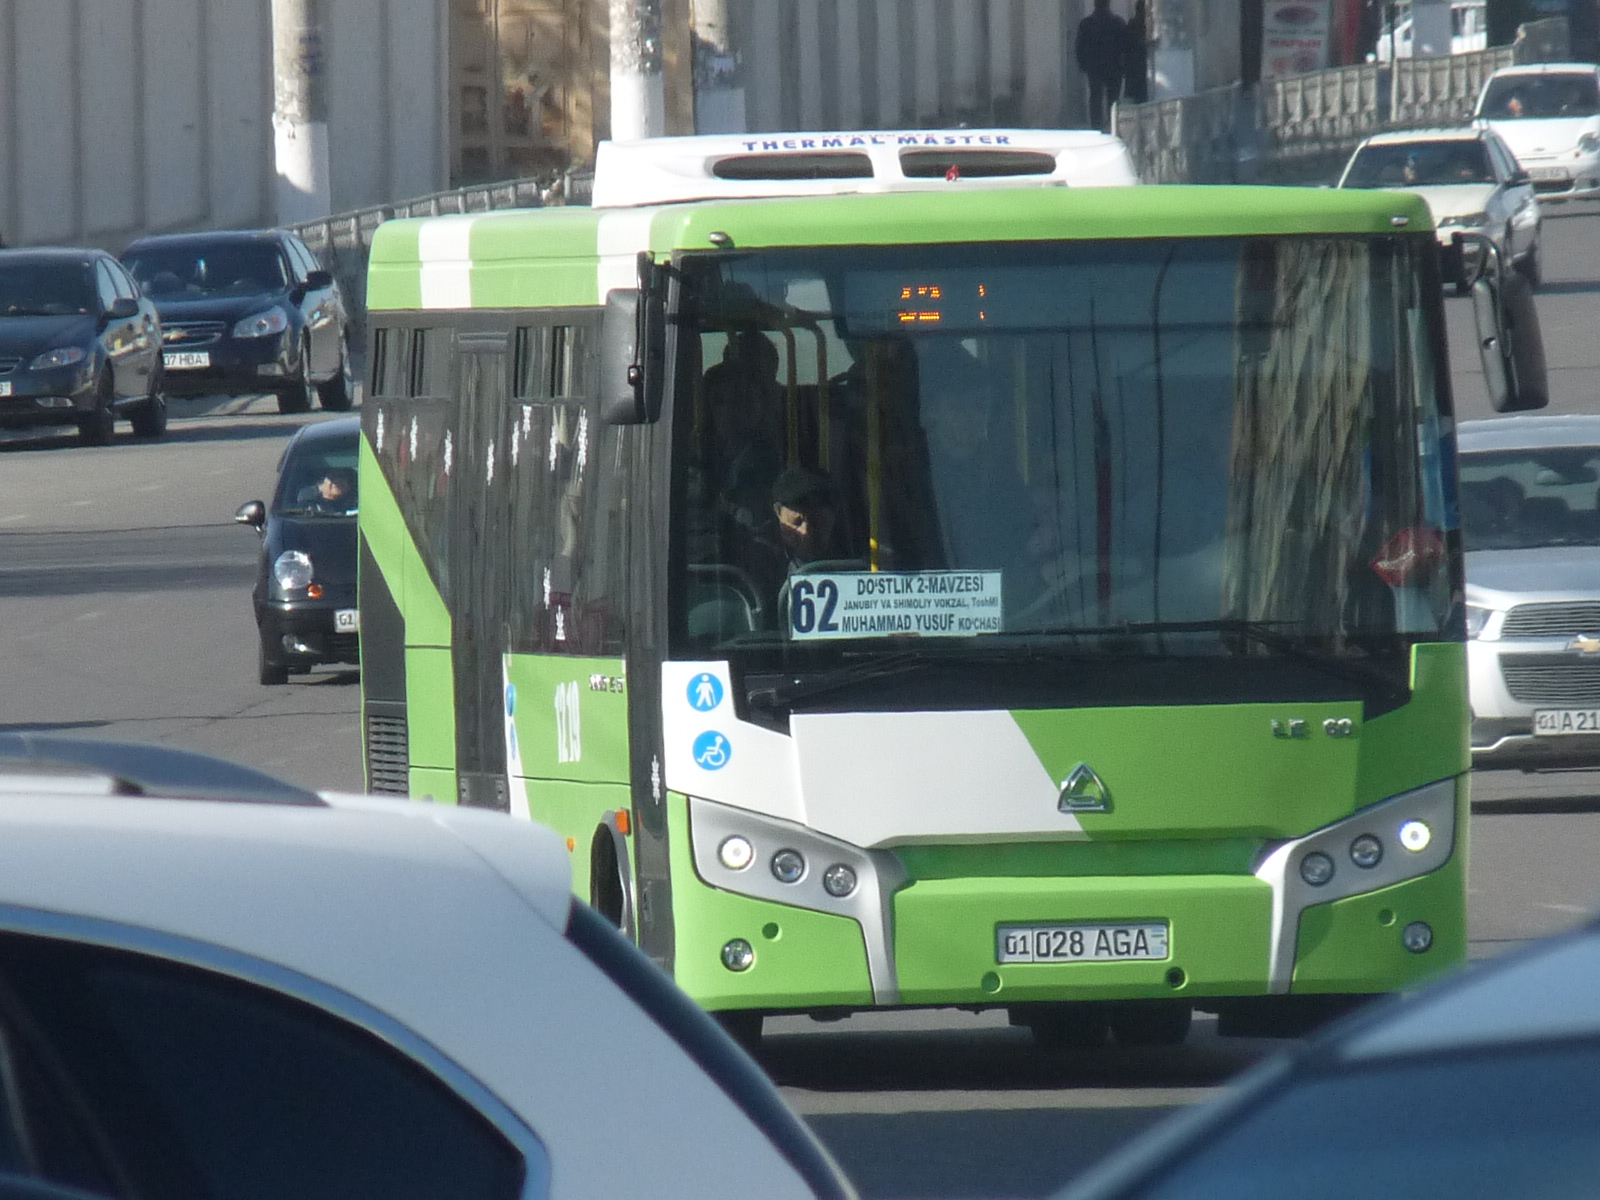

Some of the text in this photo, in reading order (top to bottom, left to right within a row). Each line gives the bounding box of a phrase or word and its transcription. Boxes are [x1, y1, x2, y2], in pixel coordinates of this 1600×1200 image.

[742, 135, 1010, 151] THERMAL MASTER
[917, 575, 984, 594] 2-MAVZESI
[792, 579, 839, 633] 62
[843, 599, 878, 611] JANUBIY
[880, 599, 892, 609] VA
[893, 598, 931, 609] SHIMOLIY
[842, 613, 911, 632] MUHAMMAD
[915, 613, 955, 631] YUSUF
[1538, 714, 1557, 730] 01
[1005, 929, 1150, 958] 01 028 AGA
